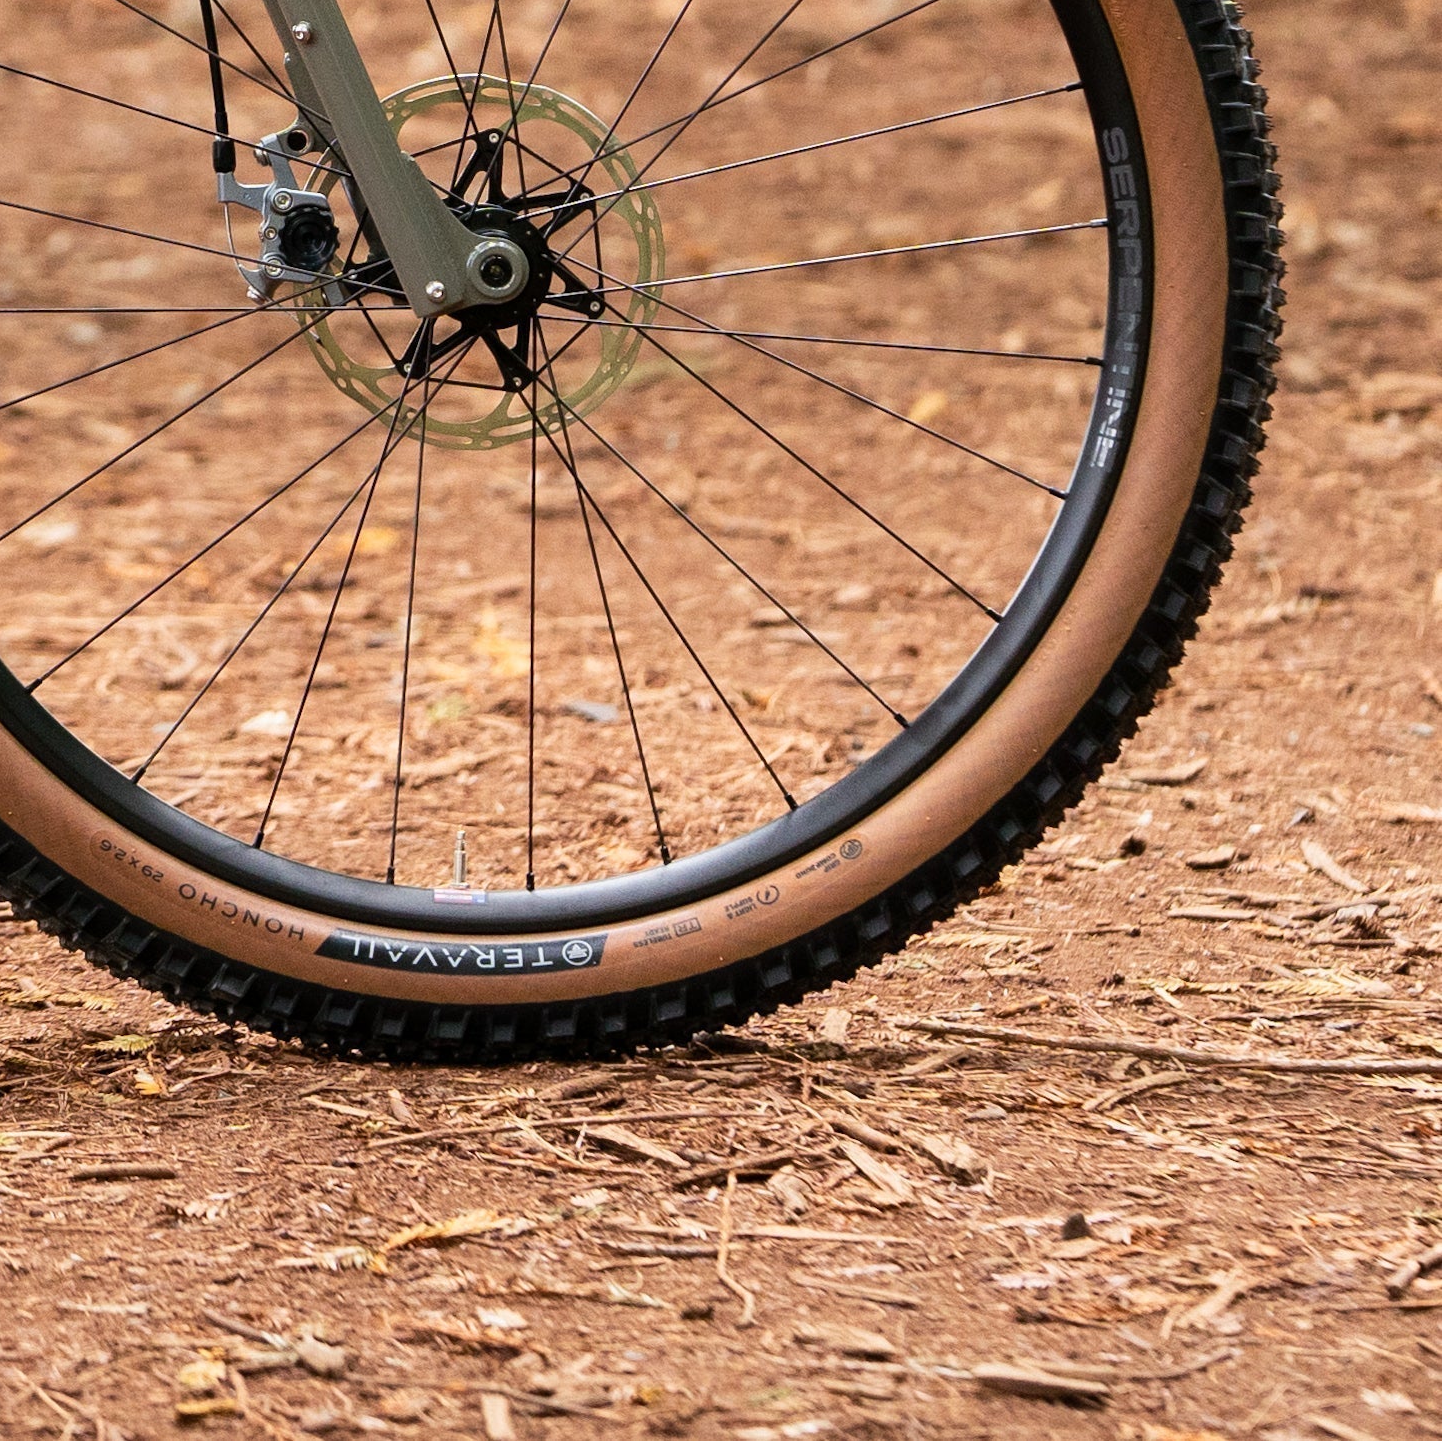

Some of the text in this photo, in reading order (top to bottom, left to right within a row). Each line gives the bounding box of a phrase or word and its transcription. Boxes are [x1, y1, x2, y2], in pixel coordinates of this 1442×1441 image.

[1090, 126, 1142, 468] SERPENTINE
[178, 883, 304, 941] HONCHO
[341, 934, 554, 968] TERAVAIL
[633, 934, 673, 948] TUBELESS
